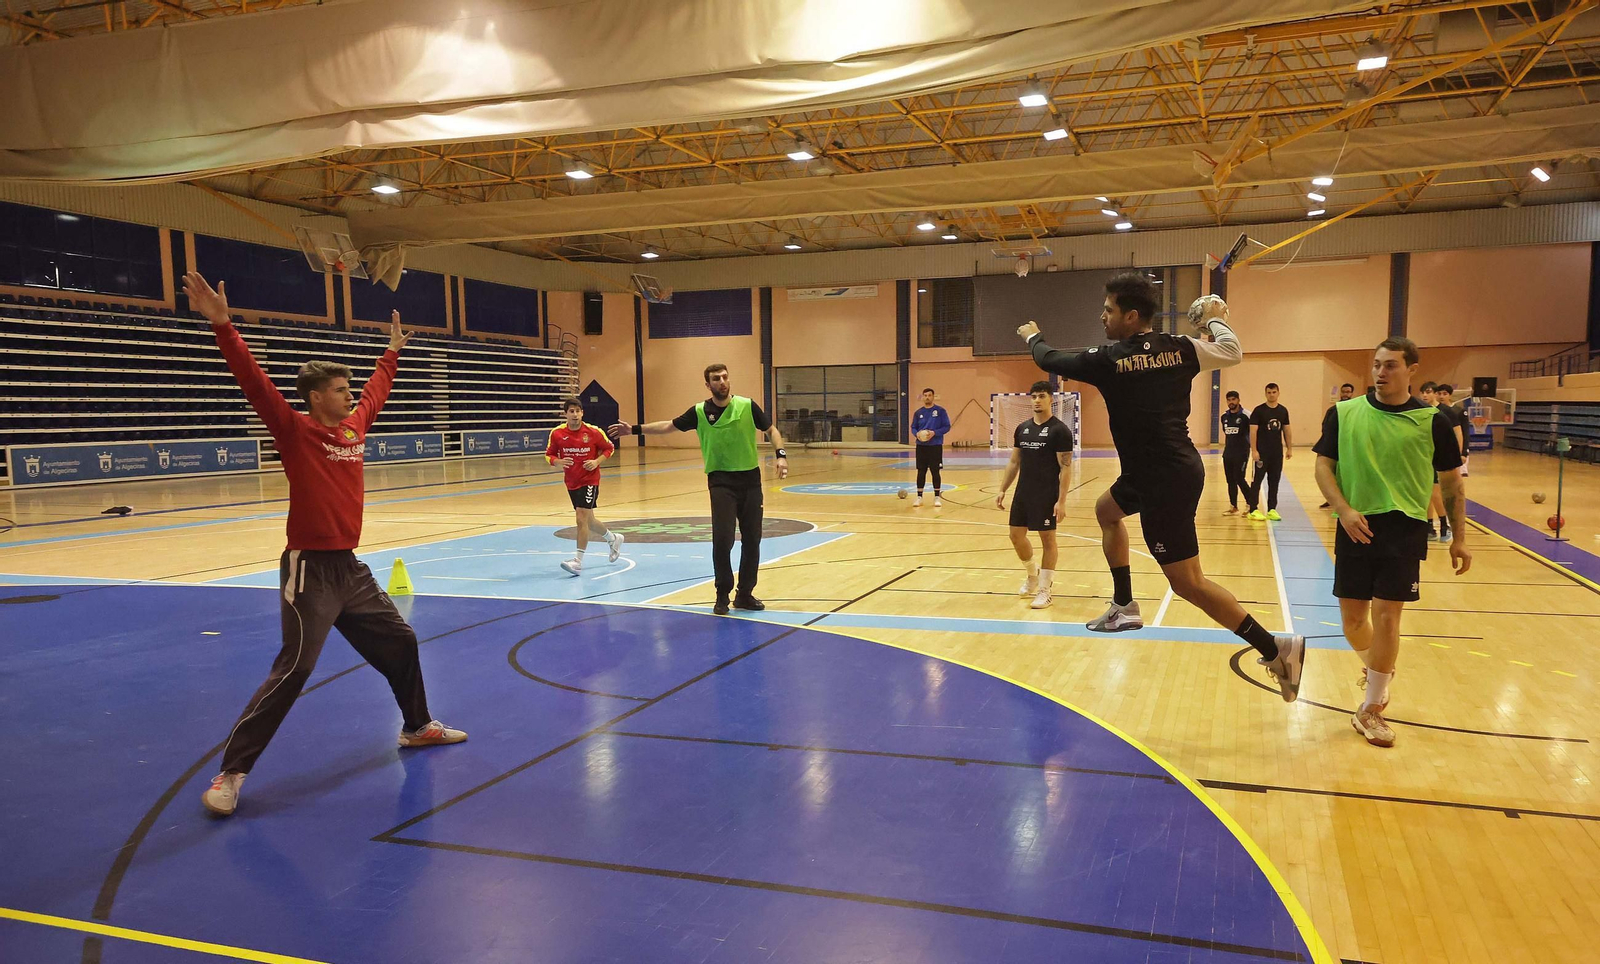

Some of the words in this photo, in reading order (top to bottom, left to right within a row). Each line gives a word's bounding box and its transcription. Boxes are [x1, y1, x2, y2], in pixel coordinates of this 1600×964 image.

[1116, 350, 1182, 373] ANAITASUNA
[43, 460, 80, 468] Ayuntamiento
[115, 456, 148, 464] Ayuntamiento
[121, 463, 146, 471] Algeciras
[51, 468, 78, 476] Algeciras
